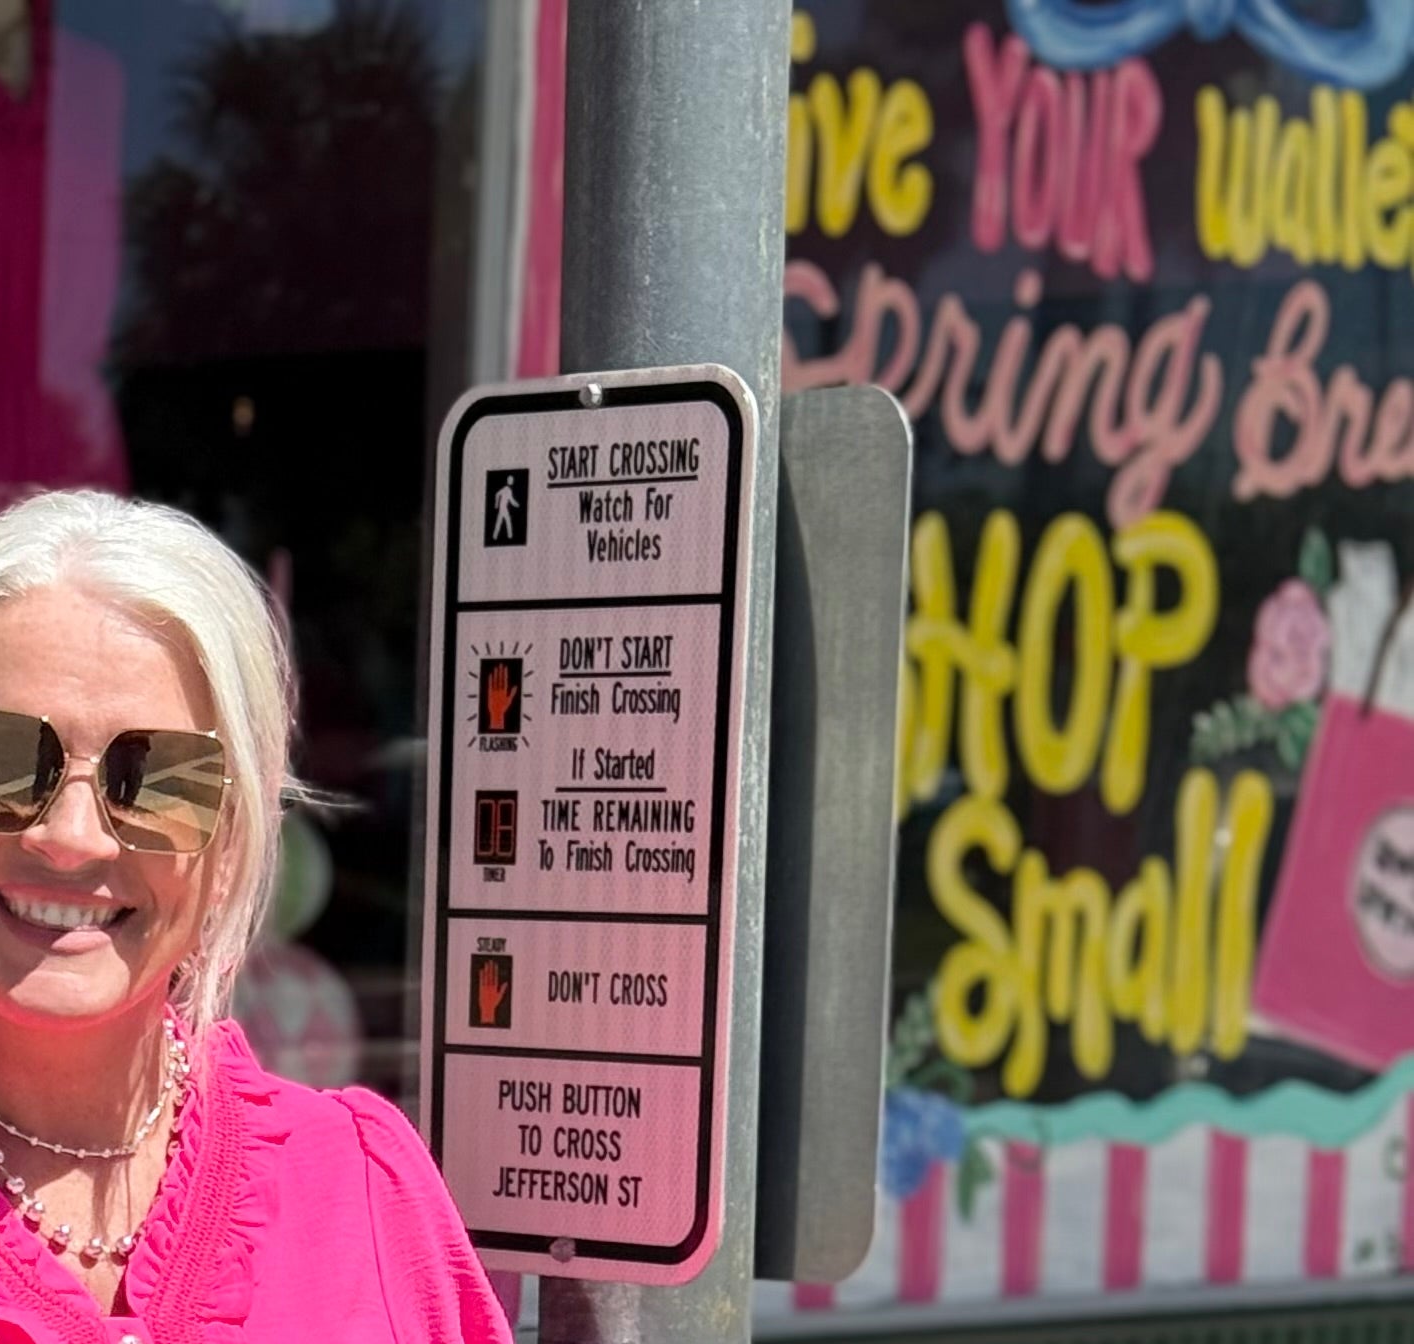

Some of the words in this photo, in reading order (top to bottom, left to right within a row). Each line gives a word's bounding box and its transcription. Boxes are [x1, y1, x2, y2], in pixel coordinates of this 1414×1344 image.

[784, 8, 934, 238] ive
[963, 22, 1163, 282] YOUR
[548, 444, 598, 480] START
[610, 438, 700, 477] CROSSING
[579, 489, 633, 524] Watch
[645, 487, 673, 520] For
[587, 529, 662, 562] Vehicles
[560, 637, 613, 670] DON'T
[622, 636, 673, 668] START
[900, 508, 1221, 815] HOP
[551, 683, 600, 714] Finish
[613, 682, 680, 721] Crossing
[572, 748, 585, 780] If
[595, 748, 655, 780] Started
[542, 800, 580, 832] TIME
[594, 801, 695, 833] REMAINING
[538, 840, 553, 870] To
[566, 841, 612, 872] Finish
[626, 841, 695, 882] Crossing
[926, 768, 1274, 1098] Small
[548, 971, 600, 1004] DON'T
[609, 974, 667, 1006] CROSS
[498, 1080, 551, 1113] PUSH
[563, 1084, 641, 1118] BUTTON
[518, 1124, 542, 1155] TO
[553, 1127, 621, 1161] CROSS
[493, 1167, 609, 1206] JEFFERSON
[618, 1177, 642, 1208] ST
